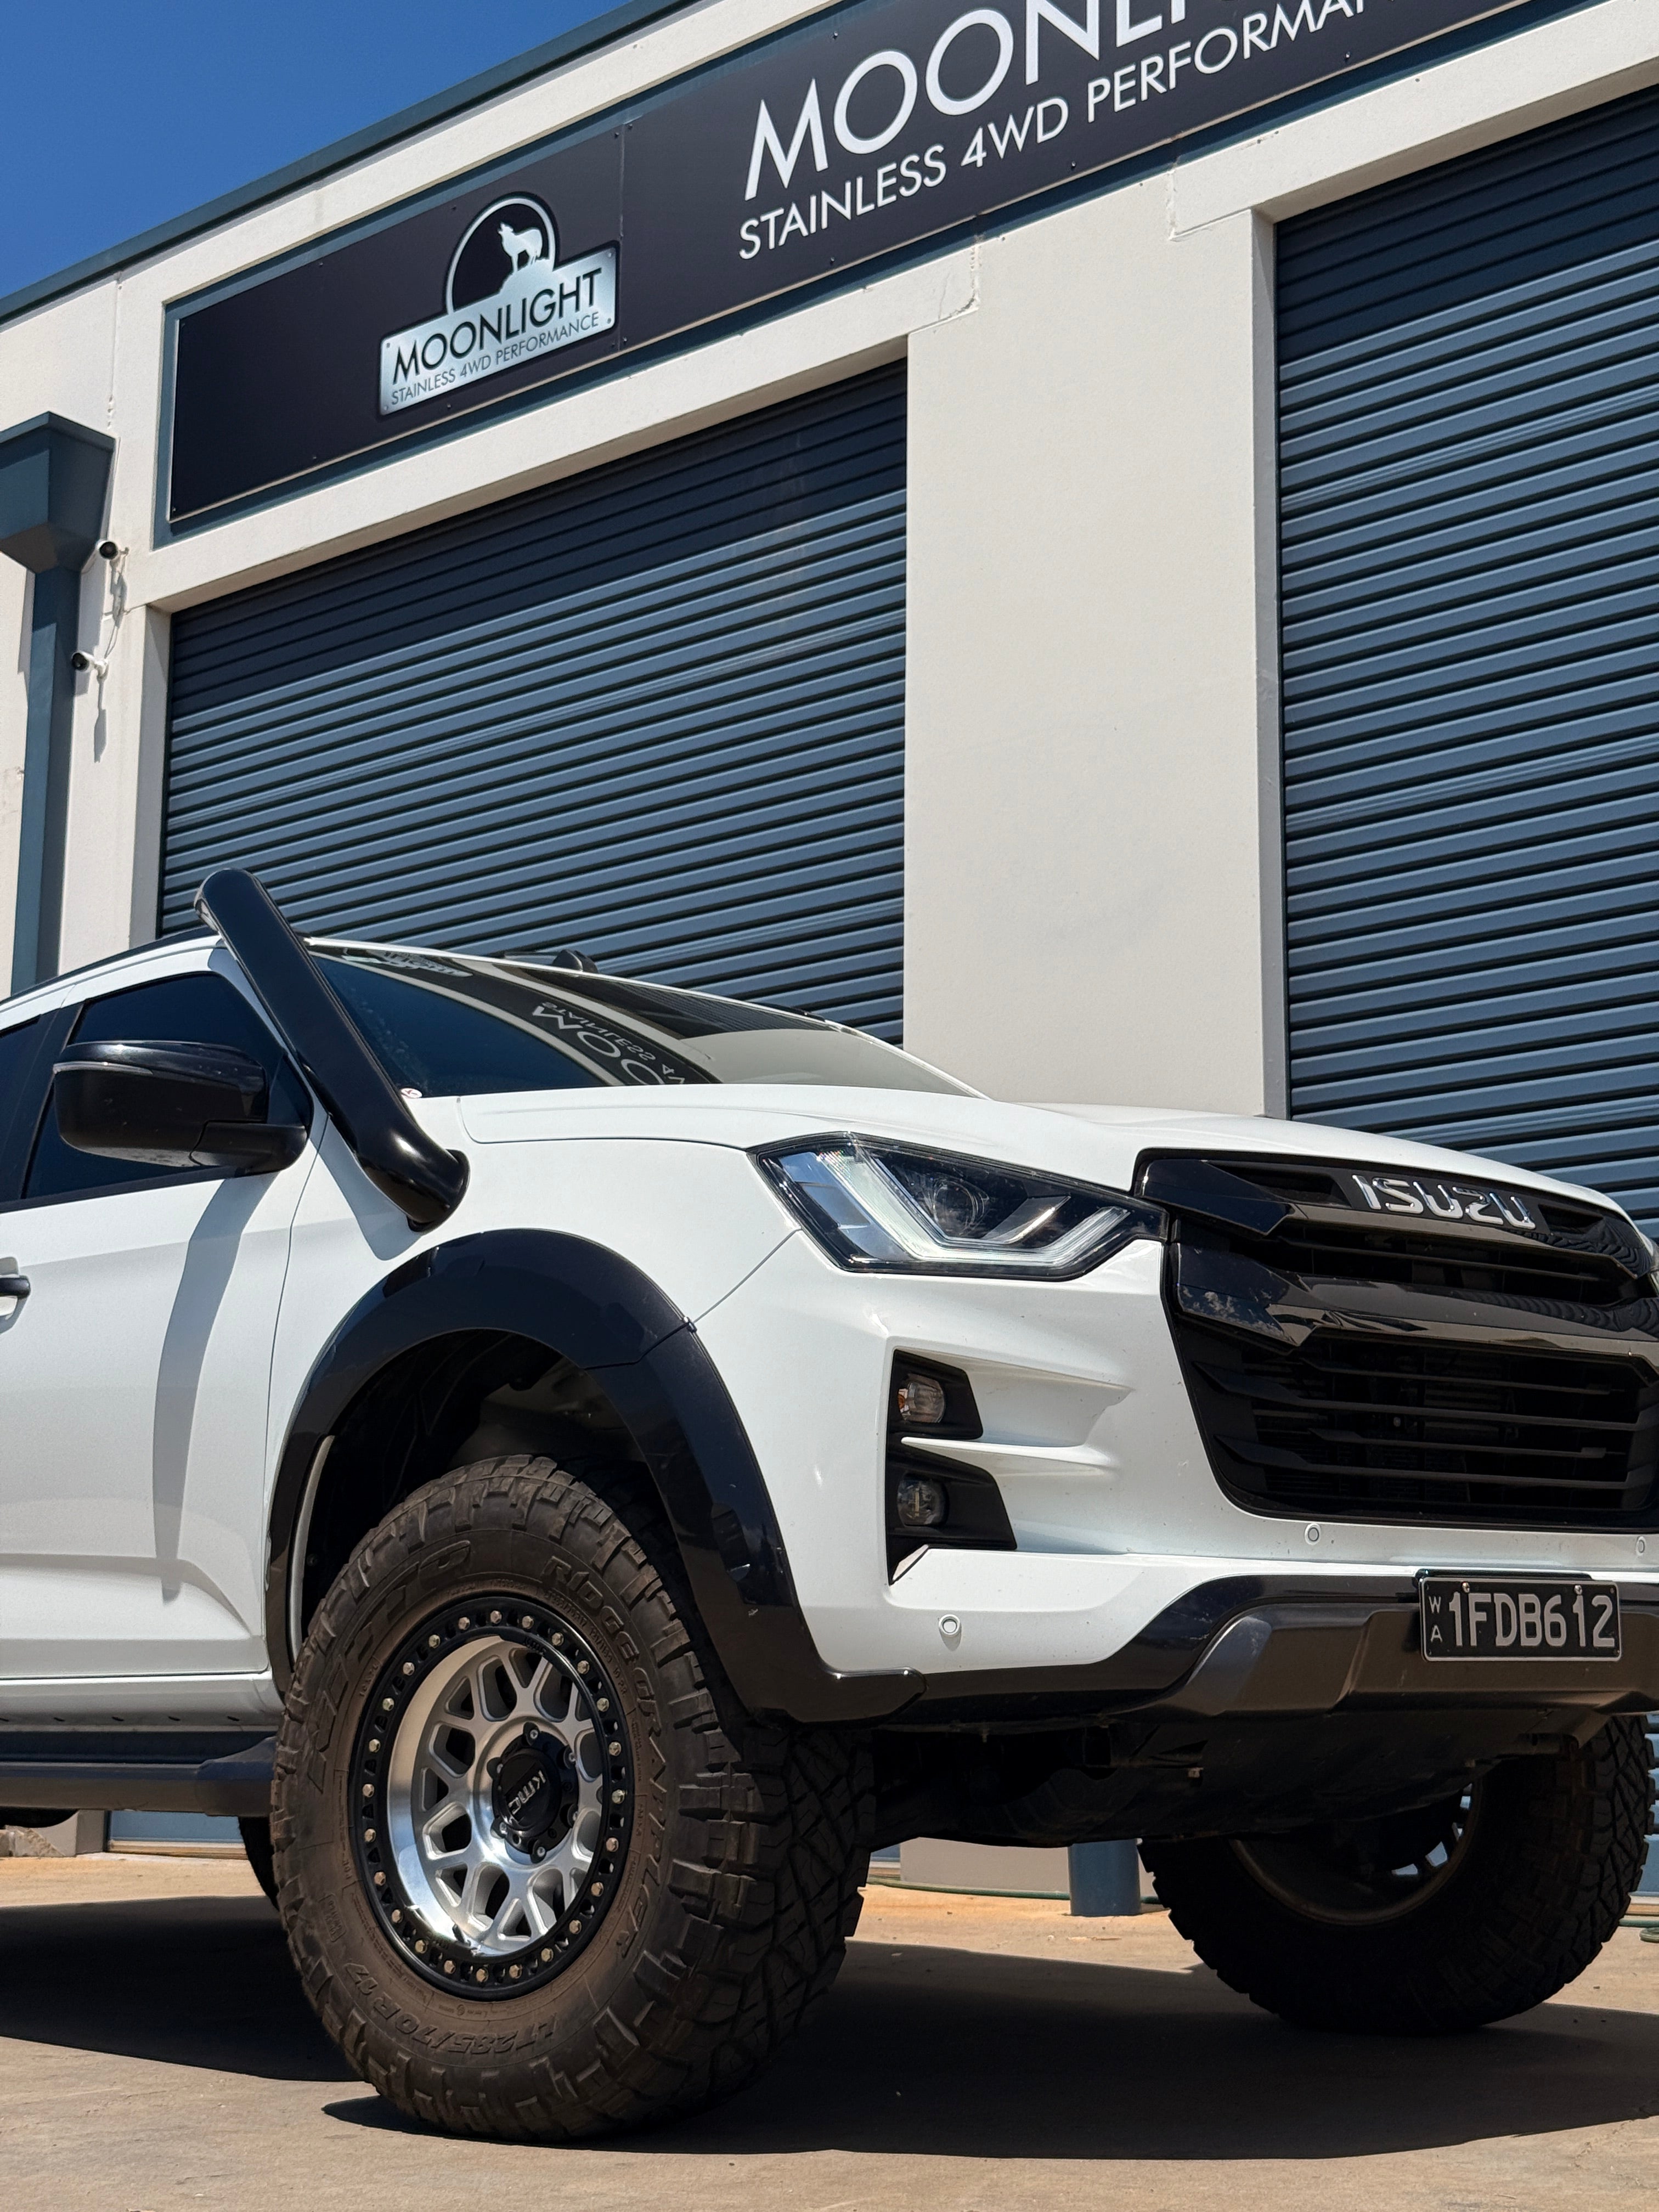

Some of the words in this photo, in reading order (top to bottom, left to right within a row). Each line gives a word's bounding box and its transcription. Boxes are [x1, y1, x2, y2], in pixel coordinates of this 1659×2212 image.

[744, 0, 1186, 201] MOONL
[738, 145, 946, 259] STAINLESS
[961, 98, 1069, 167] 4WD
[391, 369, 455, 405] STAINLESS
[460, 354, 492, 378] 4WD
[495, 311, 599, 365] PERFORMANCE
[393, 267, 602, 385] MOONLIGHT
[1351, 1175, 1536, 1229] ISUZU
[1448, 1592, 1615, 1647] 1FDB612
[508, 1769, 546, 1815] KMC
